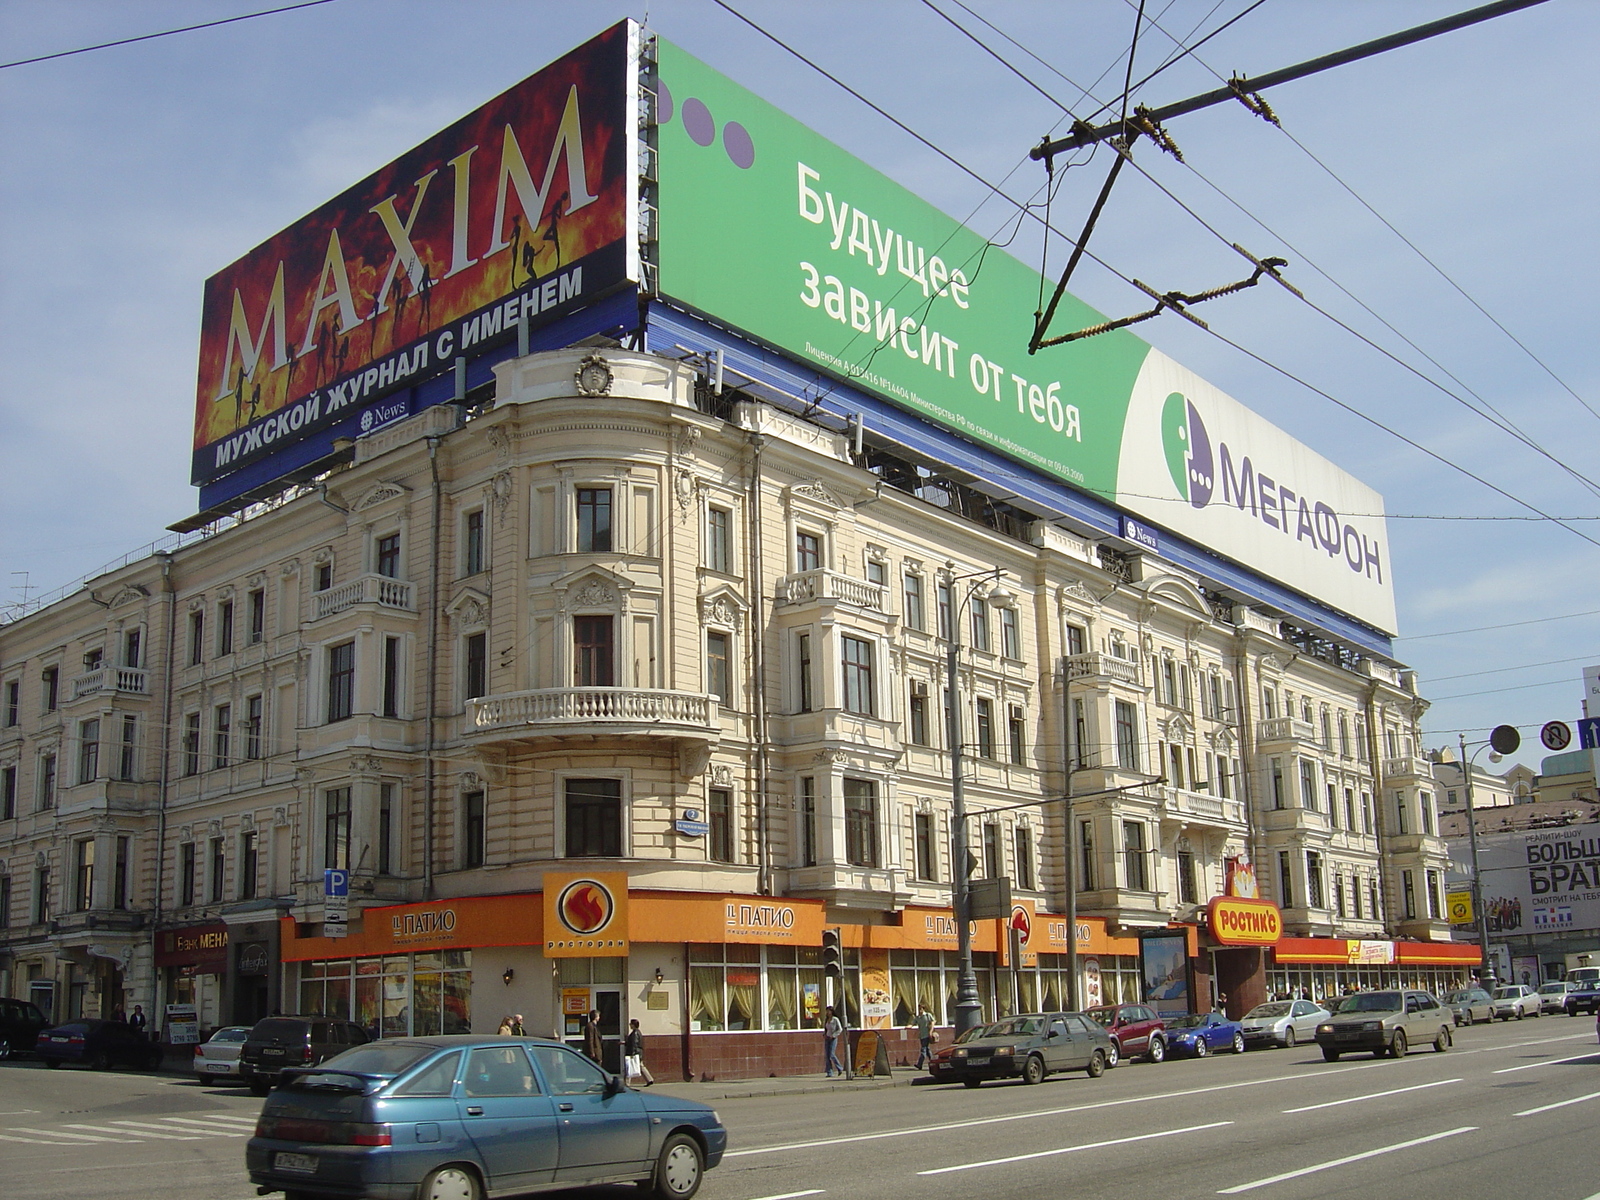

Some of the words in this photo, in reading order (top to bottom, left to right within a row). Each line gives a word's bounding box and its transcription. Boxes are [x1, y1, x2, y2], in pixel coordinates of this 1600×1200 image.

[215, 83, 598, 401] MAXIM
[798, 161, 970, 309] Будущее
[800, 261, 958, 378] зависит
[970, 352, 1004, 402] от
[1012, 373, 1082, 442] тебя
[215, 391, 320, 468] МУЖСКОЙ
[326, 341, 429, 414] ЖУРНАЛ
[436, 331, 454, 360] С
[461, 266, 582, 349] ИМЕНЕМ
[805, 341, 842, 369] Лицензия
[880, 377, 909, 400] №14404
[910, 392, 955, 422] Министерства
[956, 413, 966, 426] РФ
[966, 421, 975, 431] по
[976, 425, 993, 440] связи
[375, 402, 405, 424] News
[1219, 442, 1383, 585] МЕГАФОН
[1136, 526, 1156, 547] News
[1525, 830, 1582, 843] РЕАЛИТИ-ШОУ
[1532, 895, 1567, 906] СМОТРИТ
[393, 915, 401, 930] IL
[404, 908, 456, 935] ПАТИО
[727, 904, 736, 918] IL
[740, 904, 795, 930] ПАТИО
[936, 916, 977, 937] ПАТО
[1219, 909, 1277, 934] РОСТИК'С
[177, 936, 198, 951] Банк
[547, 940, 625, 950] ресторан
[1057, 923, 1091, 942] ПИО
